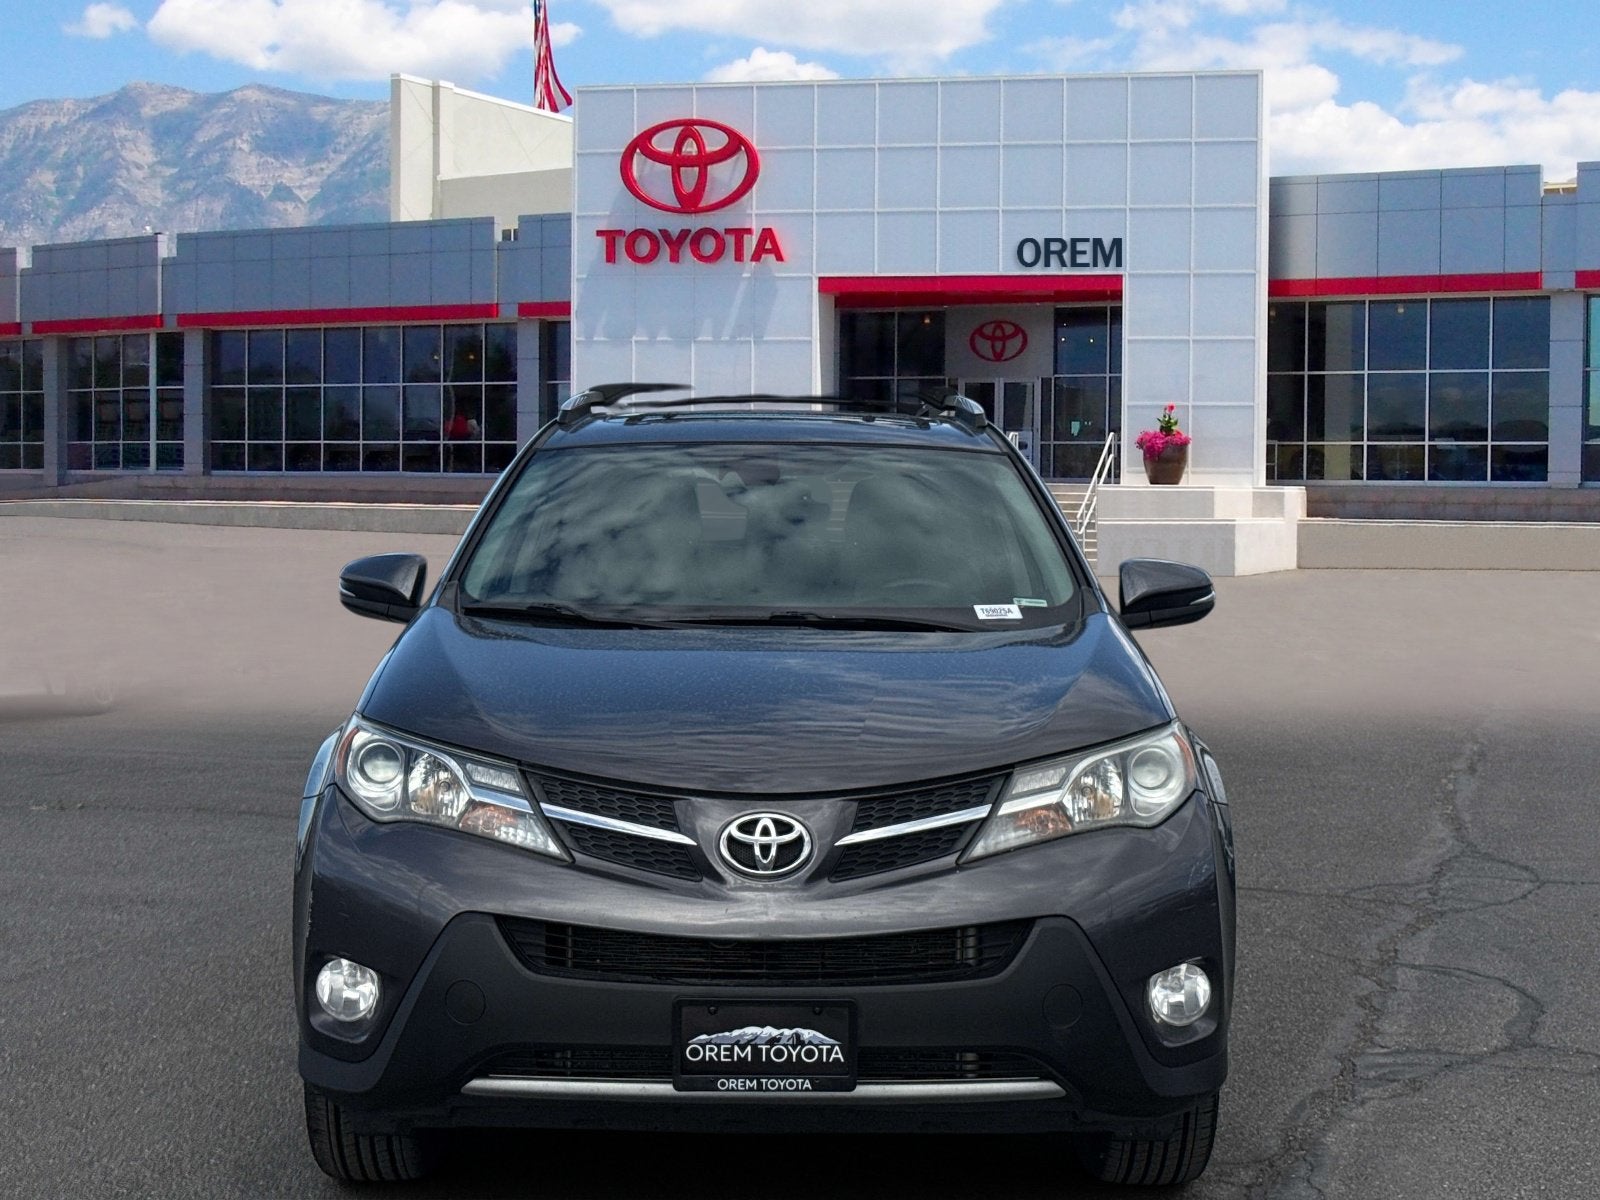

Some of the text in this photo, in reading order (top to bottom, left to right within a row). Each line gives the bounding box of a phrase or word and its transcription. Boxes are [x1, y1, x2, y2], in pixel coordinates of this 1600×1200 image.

[596, 227, 785, 264] TOYOTA
[1016, 238, 1123, 268] OREM
[686, 1044, 844, 1062] OREM TOYOTA
[717, 1078, 812, 1090] OREM TOYOTA
